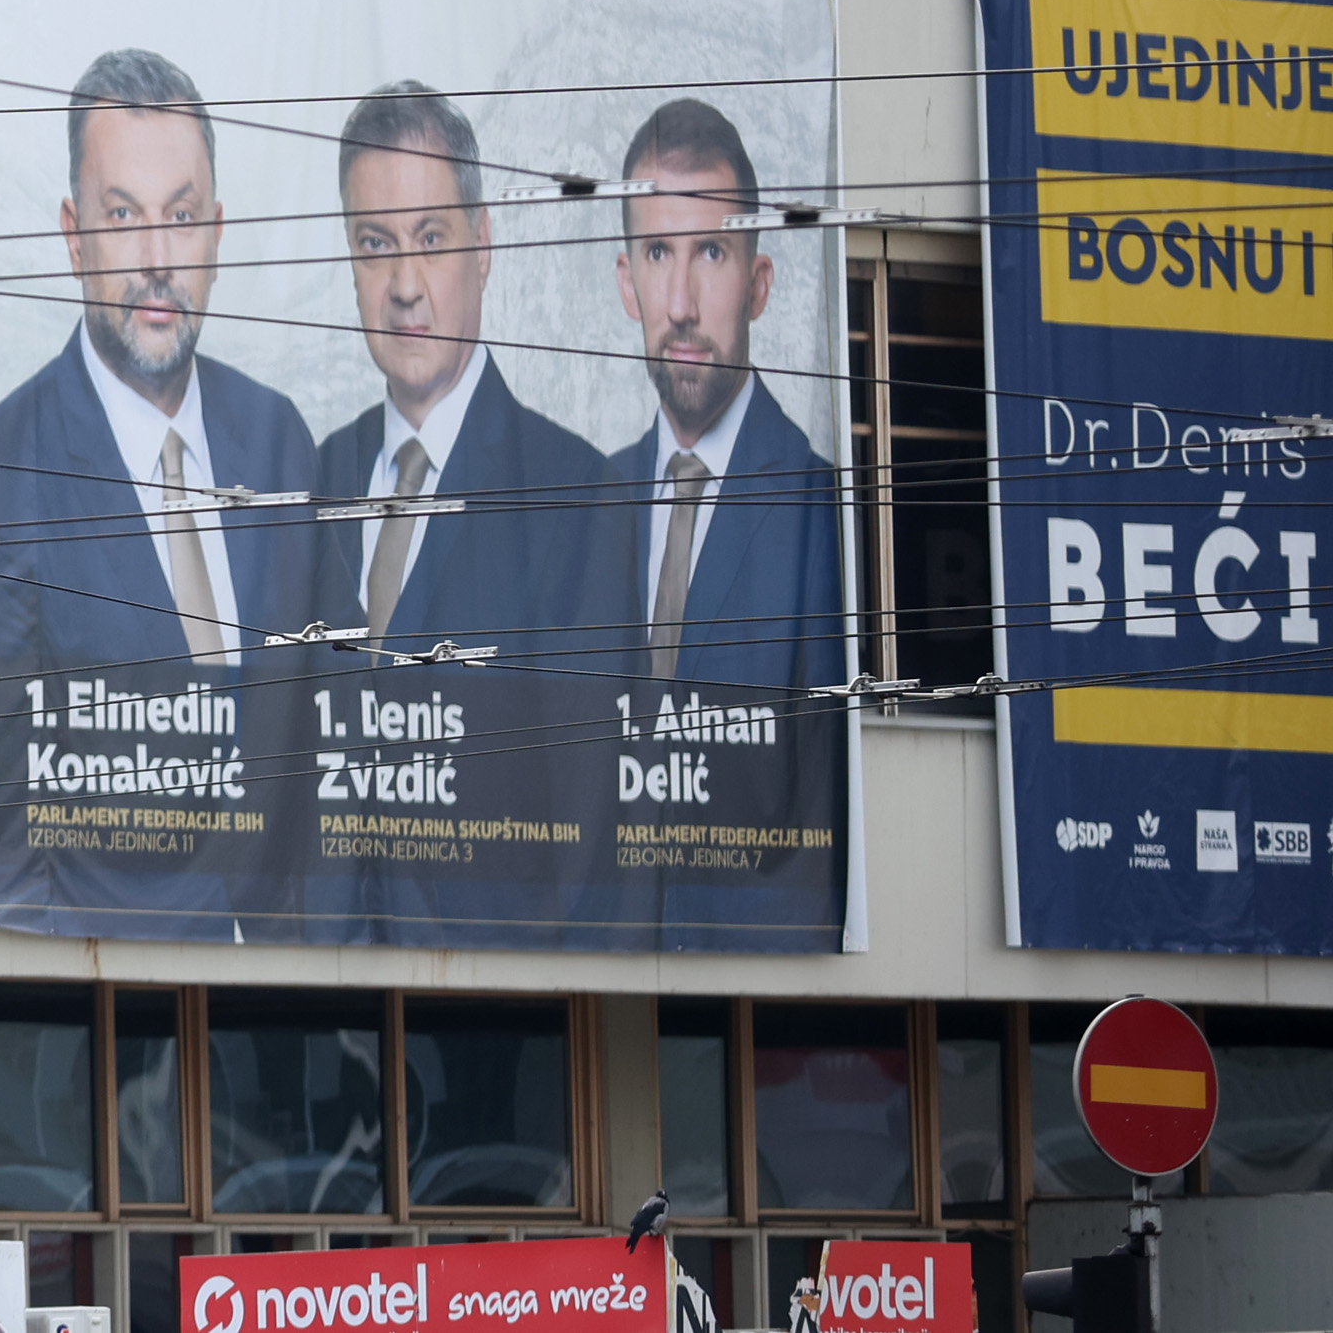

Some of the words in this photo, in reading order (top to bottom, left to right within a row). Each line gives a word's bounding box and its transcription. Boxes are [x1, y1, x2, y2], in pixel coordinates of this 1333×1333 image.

[1068, 215, 1283, 295] BOSNU
[1303, 231, 1314, 296] I
[25, 679, 57, 728] 1.
[68, 678, 236, 735] Elmedin
[314, 689, 346, 738] 1.
[616, 693, 640, 741] 1.
[653, 692, 776, 745] Adnan
[27, 742, 246, 799] Konaković
[619, 752, 710, 804] Delić
[27, 805, 130, 827] PARLAMENT
[134, 808, 231, 831] FEDERACIJE
[234, 812, 264, 832] BIH
[459, 816, 550, 841] SKUPŠTINA
[553, 822, 581, 843] BIH
[27, 828, 102, 850] IZBORNA
[105, 830, 178, 853] JEDINICA
[182, 834, 195, 854] 11
[710, 826, 799, 847] FEDERACIJE
[802, 829, 832, 848] BIH
[1077, 822, 1112, 848] SDP
[1204, 827, 1228, 840] NAŠA
[1274, 829, 1309, 853] SBB
[322, 837, 387, 859] IZBORN
[390, 840, 460, 862] JEDINICA
[464, 845, 473, 864] 3
[689, 848, 749, 869] JEDINICA
[754, 850, 763, 871] 7
[257, 1263, 427, 1330] novotel
[448, 1288, 538, 1323] snaga
[550, 1273, 647, 1313] mreže
